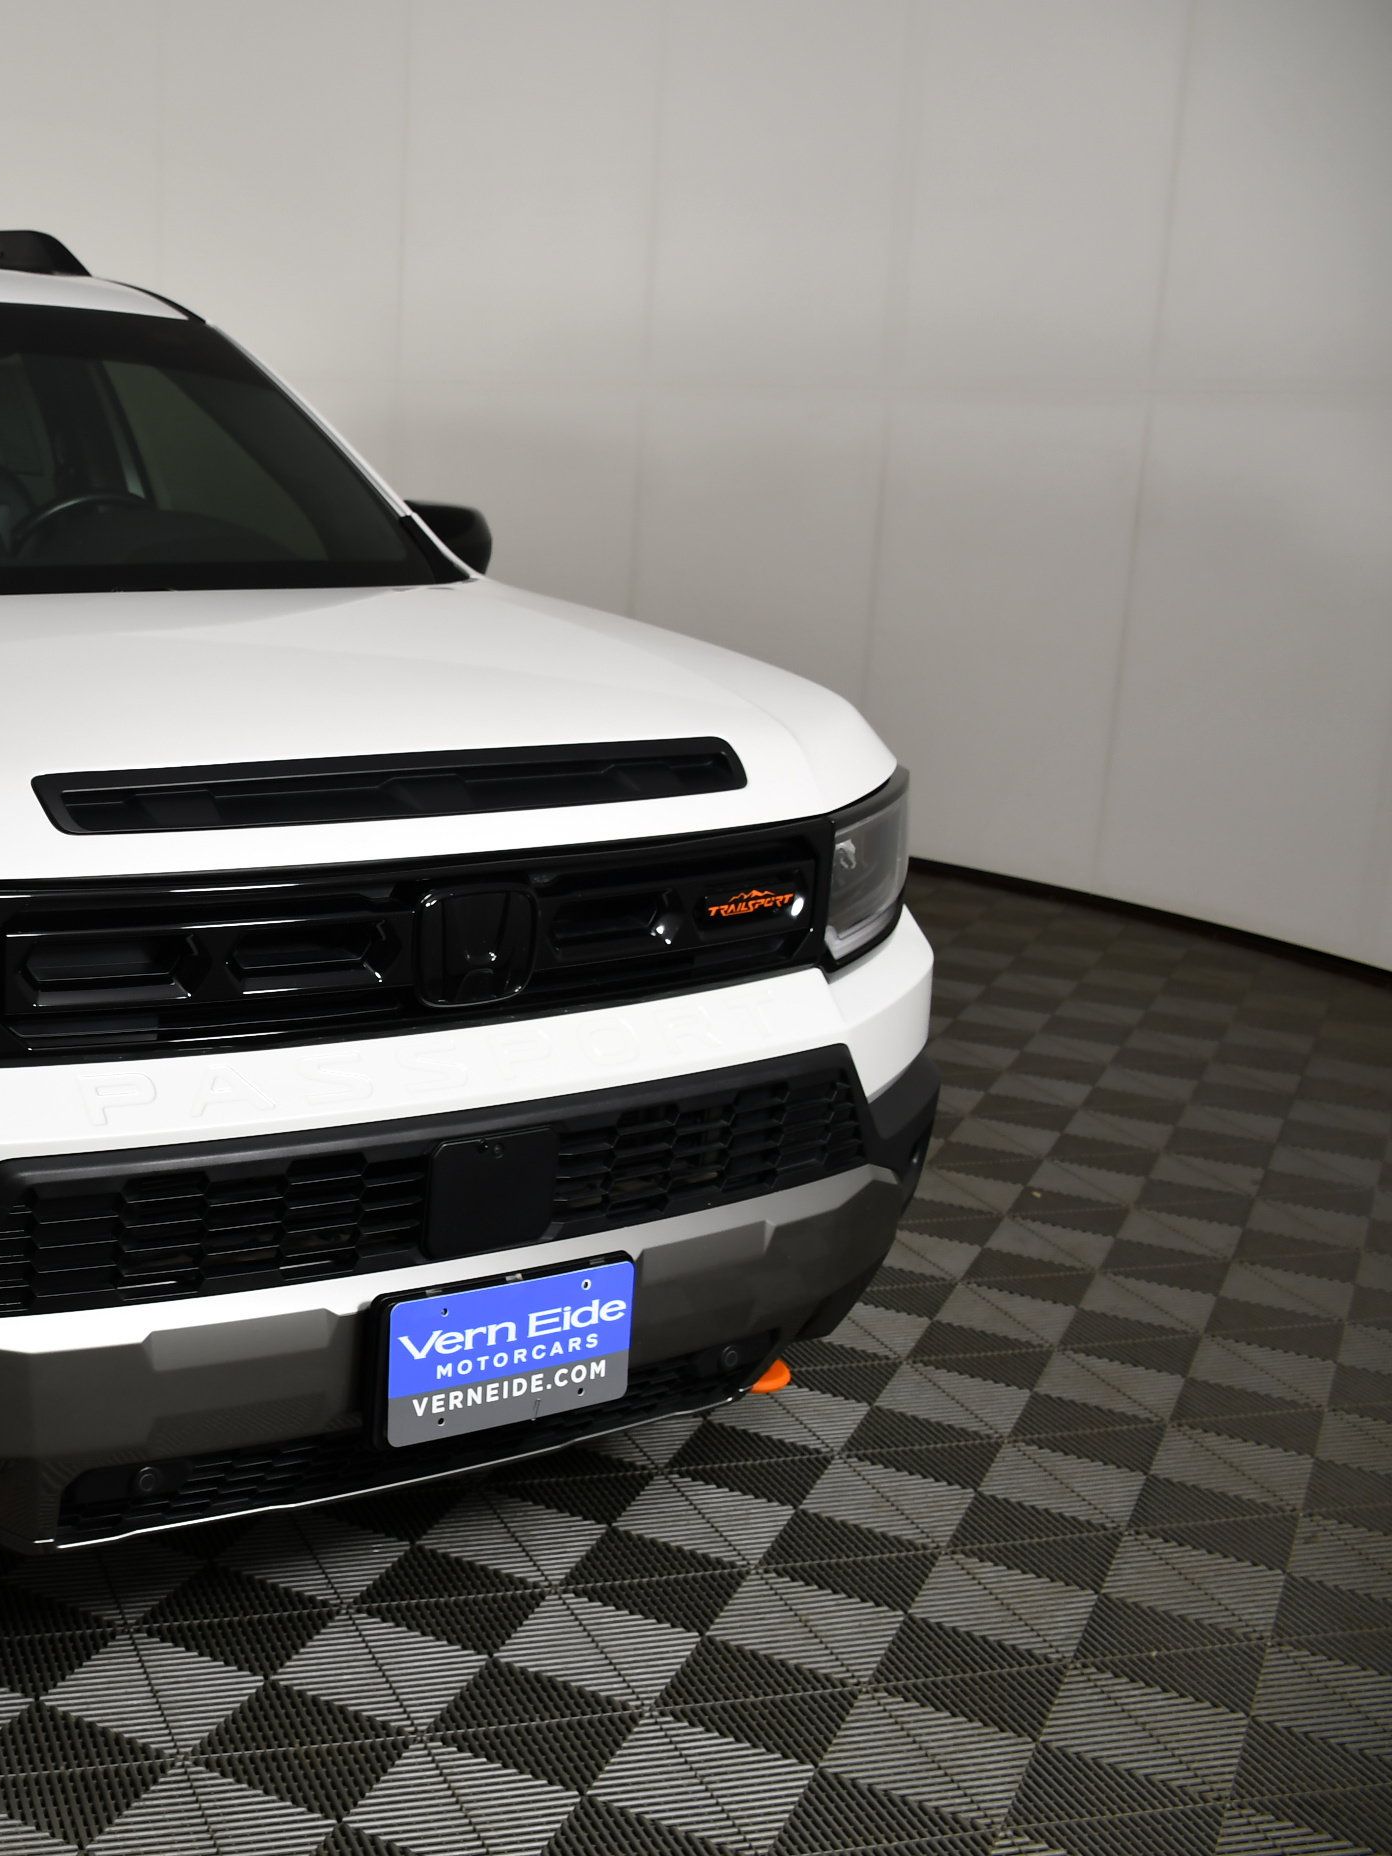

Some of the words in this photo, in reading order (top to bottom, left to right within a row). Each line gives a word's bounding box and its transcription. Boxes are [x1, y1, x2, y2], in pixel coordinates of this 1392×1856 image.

[708, 892, 794, 917] TRAILSPORT
[74, 988, 778, 1127] PASSPORT
[398, 1321, 517, 1360] Vern
[526, 1299, 627, 1338] Eide
[436, 1333, 599, 1380] MOTORCARS
[412, 1360, 607, 1417] VERNEIDE.COM
